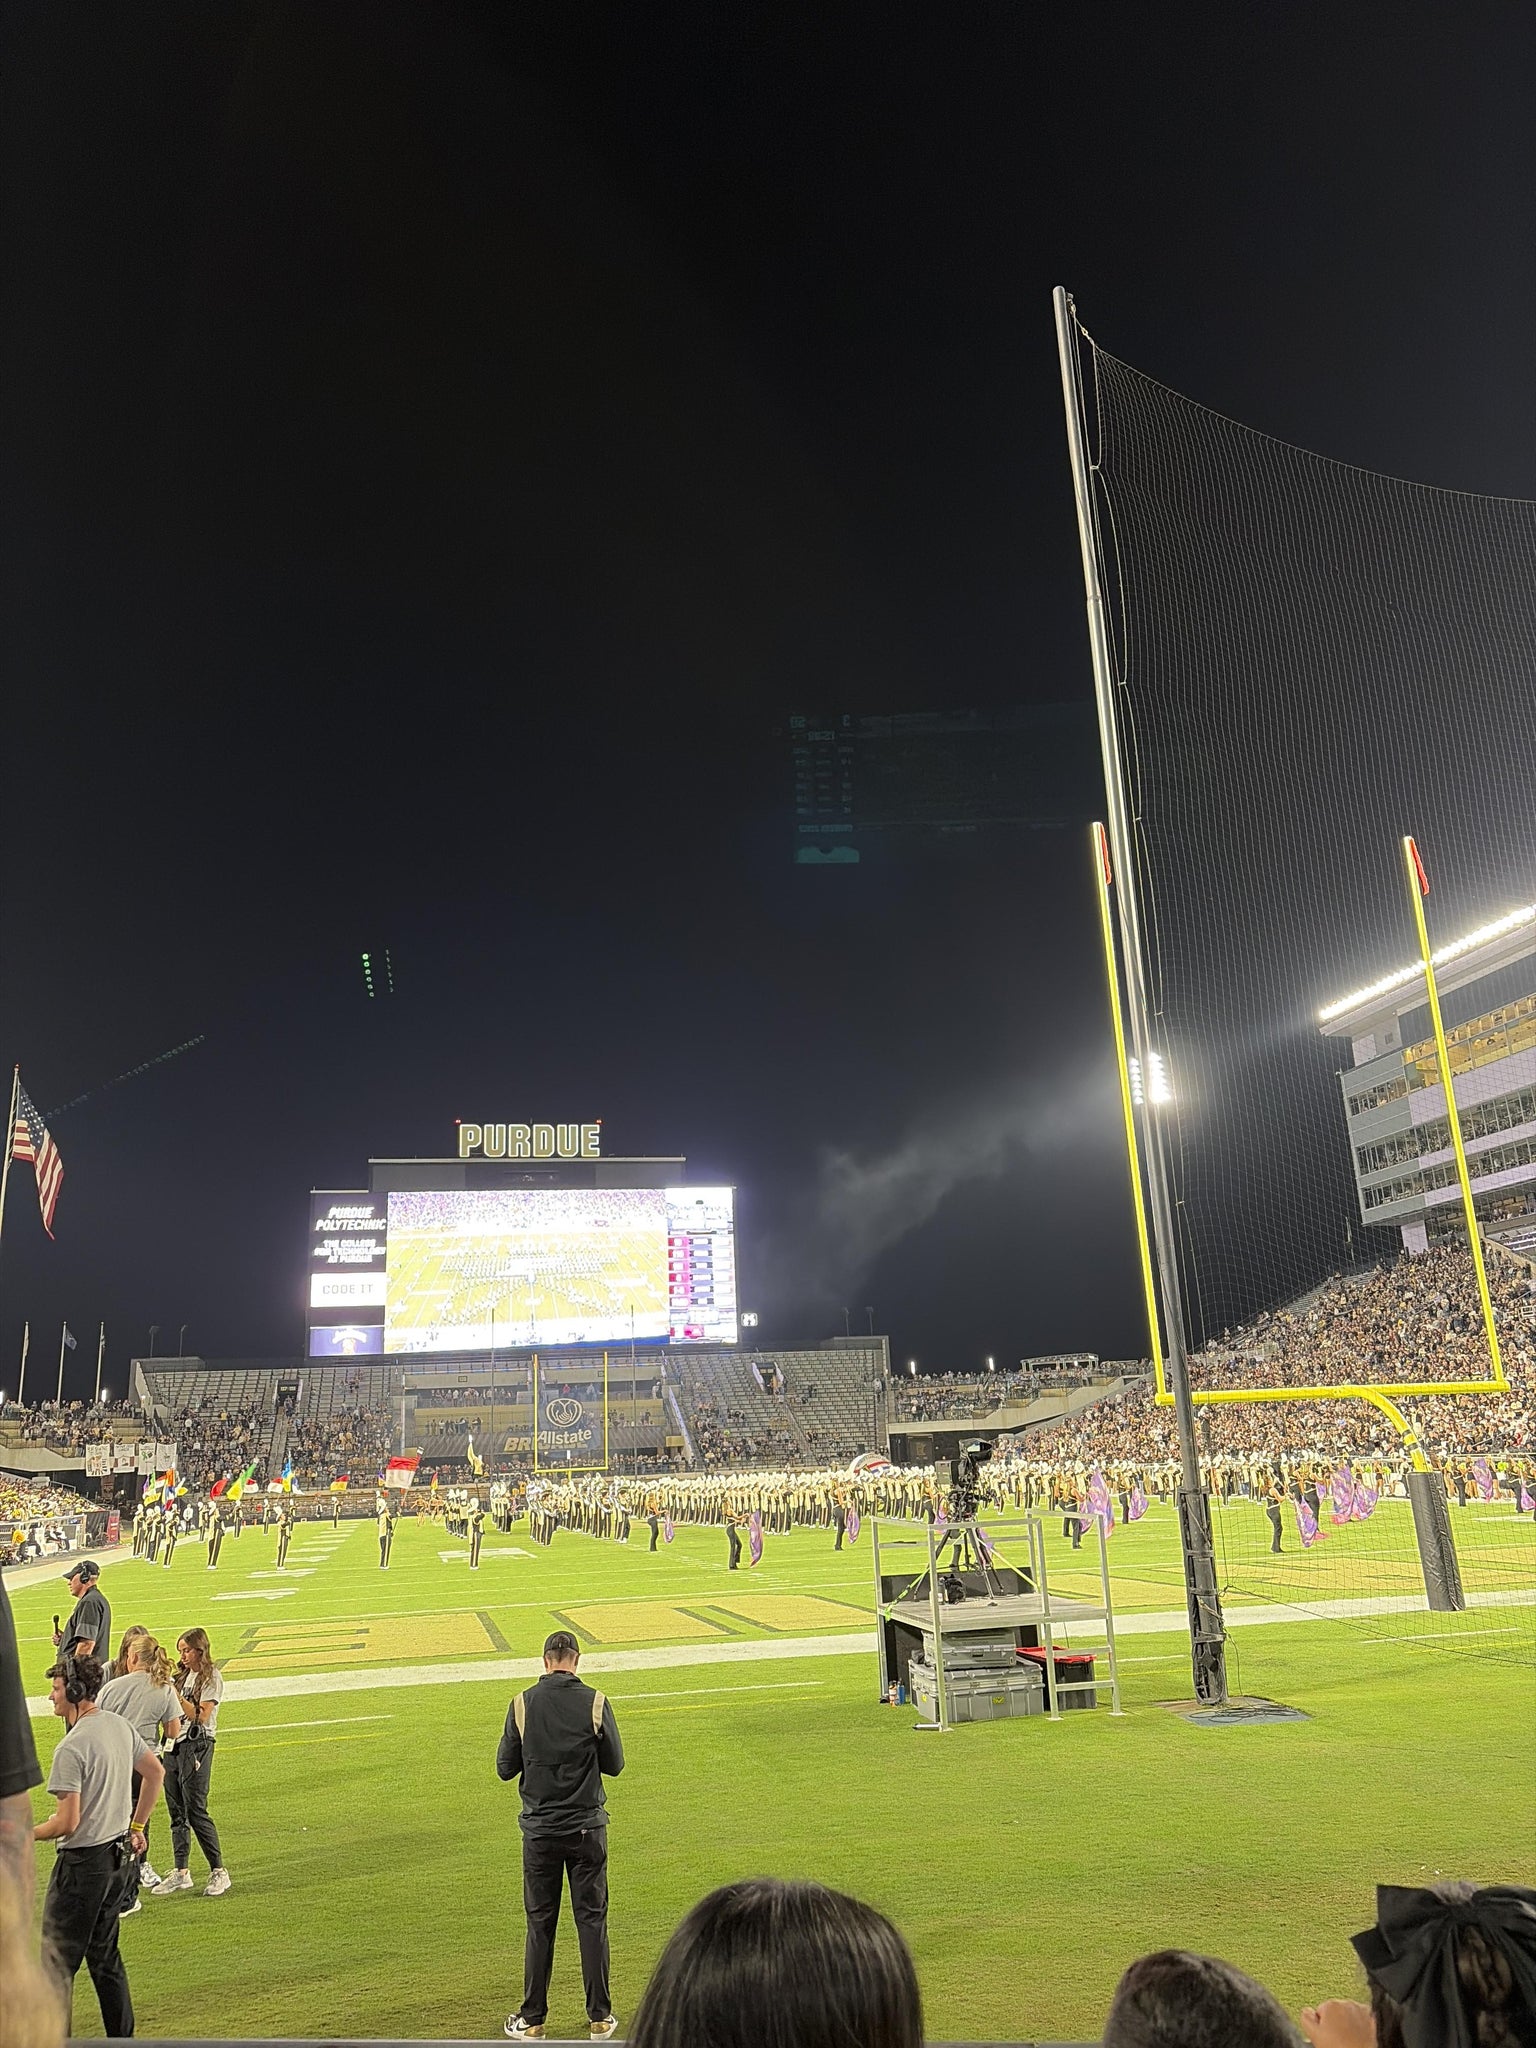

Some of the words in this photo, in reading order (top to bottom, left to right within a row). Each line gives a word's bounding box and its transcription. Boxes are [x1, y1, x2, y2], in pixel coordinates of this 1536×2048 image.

[459, 1123, 600, 1158] PURDUE
[328, 1206, 375, 1219] PURDUE
[315, 1219, 387, 1231] POLYTECHNIC
[322, 1284, 356, 1295] CODE
[361, 1283, 374, 1294] IT
[537, 1428, 592, 1446] Allstate
